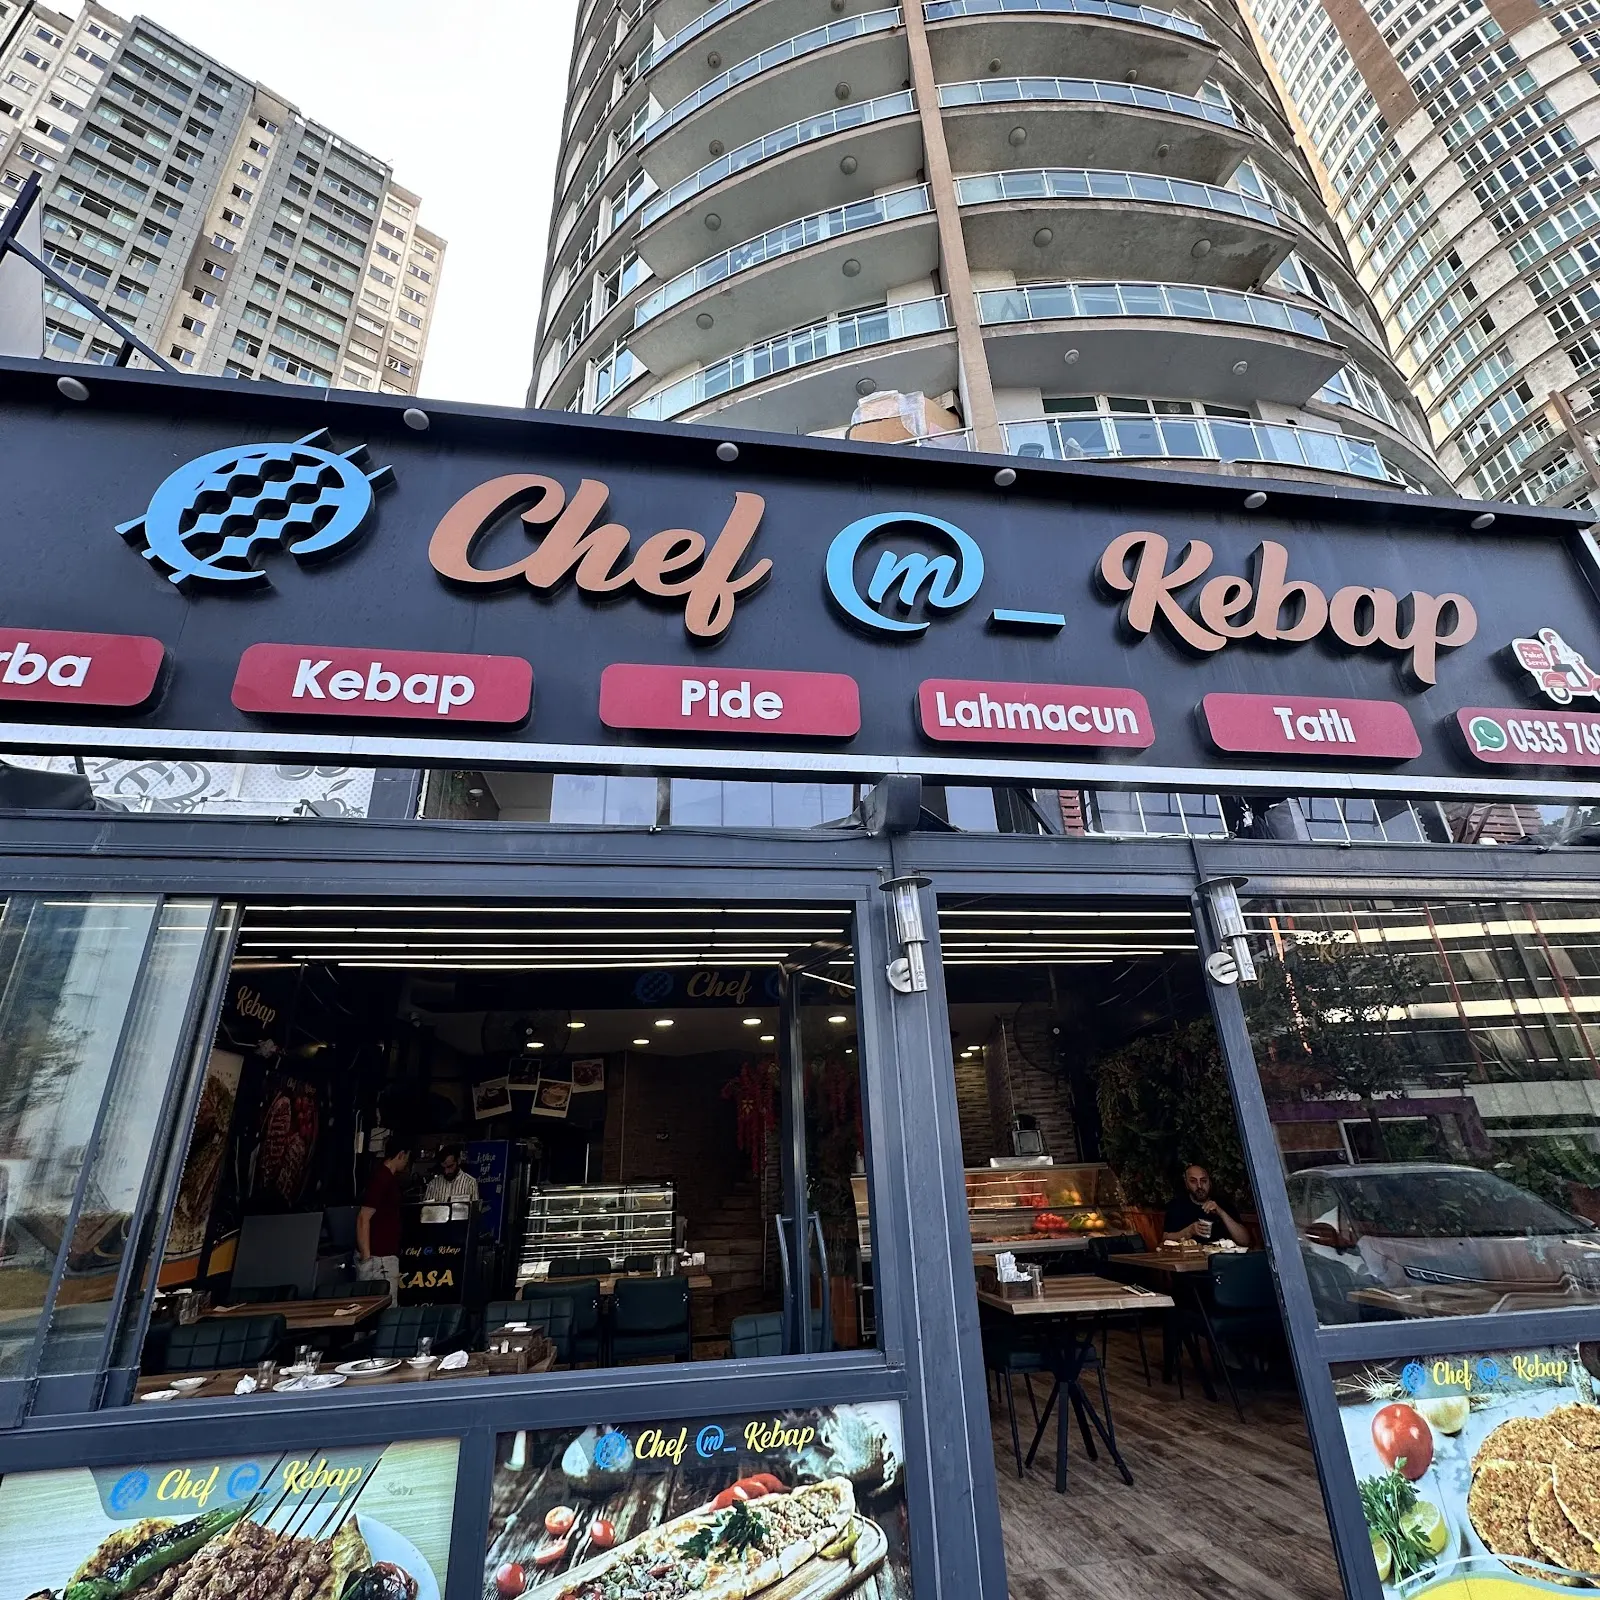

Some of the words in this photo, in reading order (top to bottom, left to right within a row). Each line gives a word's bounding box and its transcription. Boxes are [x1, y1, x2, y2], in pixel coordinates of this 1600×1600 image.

[429, 475, 772, 637] Chef
[1100, 530, 1478, 686] Kebap
[292, 659, 475, 715] Kebap
[681, 679, 784, 720] Pide
[935, 691, 1140, 734] Lahmacun
[1273, 707, 1356, 743] Tatlı
[1507, 719, 1568, 754] 0535
[236, 985, 276, 1030] Kebap
[687, 970, 753, 1005] Chef
[1432, 1359, 1473, 1392] Chef
[1512, 1354, 1568, 1384] Kebap
[635, 1426, 689, 1466] Chef
[743, 1420, 815, 1454] Kebap
[156, 1465, 220, 1508] Chef
[282, 1458, 363, 1496] Kebap
